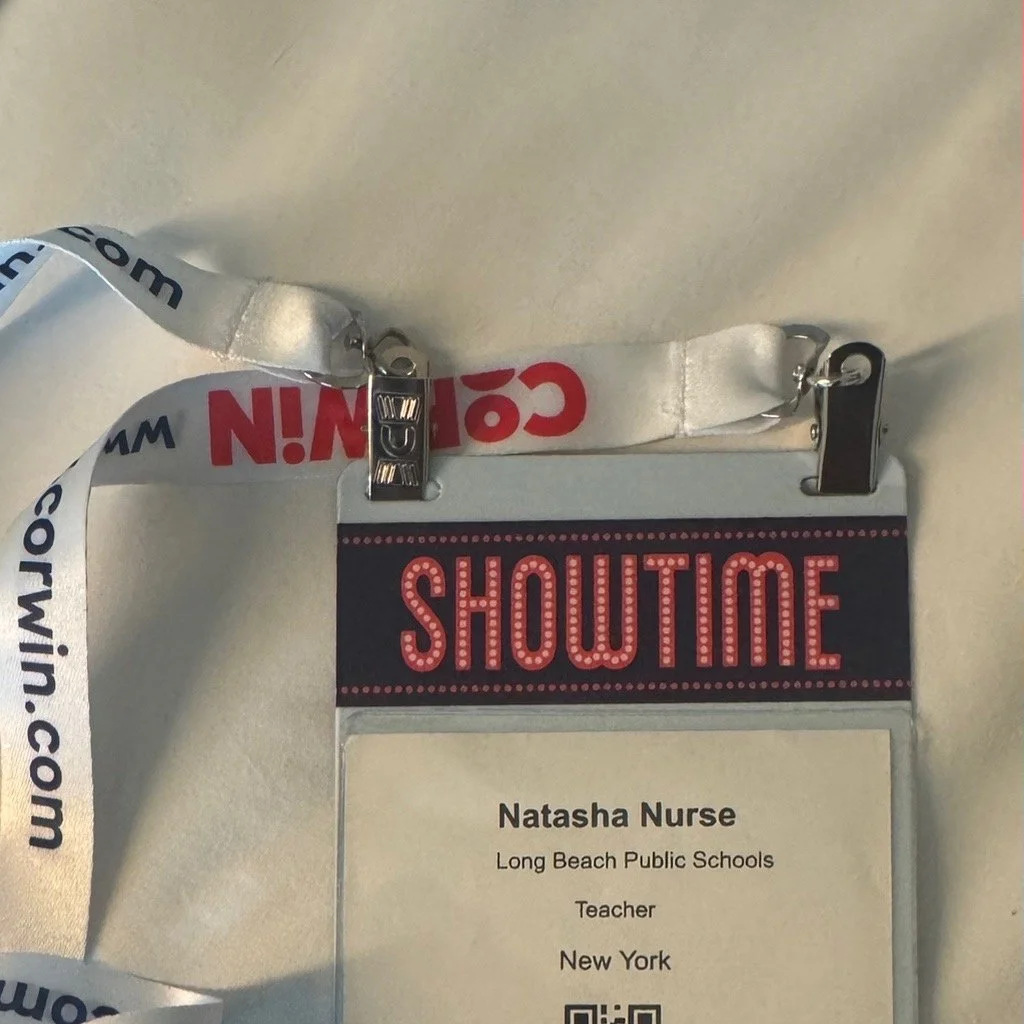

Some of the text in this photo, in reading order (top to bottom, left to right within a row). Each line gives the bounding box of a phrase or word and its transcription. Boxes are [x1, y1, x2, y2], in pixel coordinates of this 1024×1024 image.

[400, 551, 842, 672] SHOWTIME
[499, 801, 737, 829] Natasha Nurse
[496, 851, 775, 874] Long Beach Public Schools
[574, 900, 656, 918] Teacher
[559, 950, 672, 971] New York
